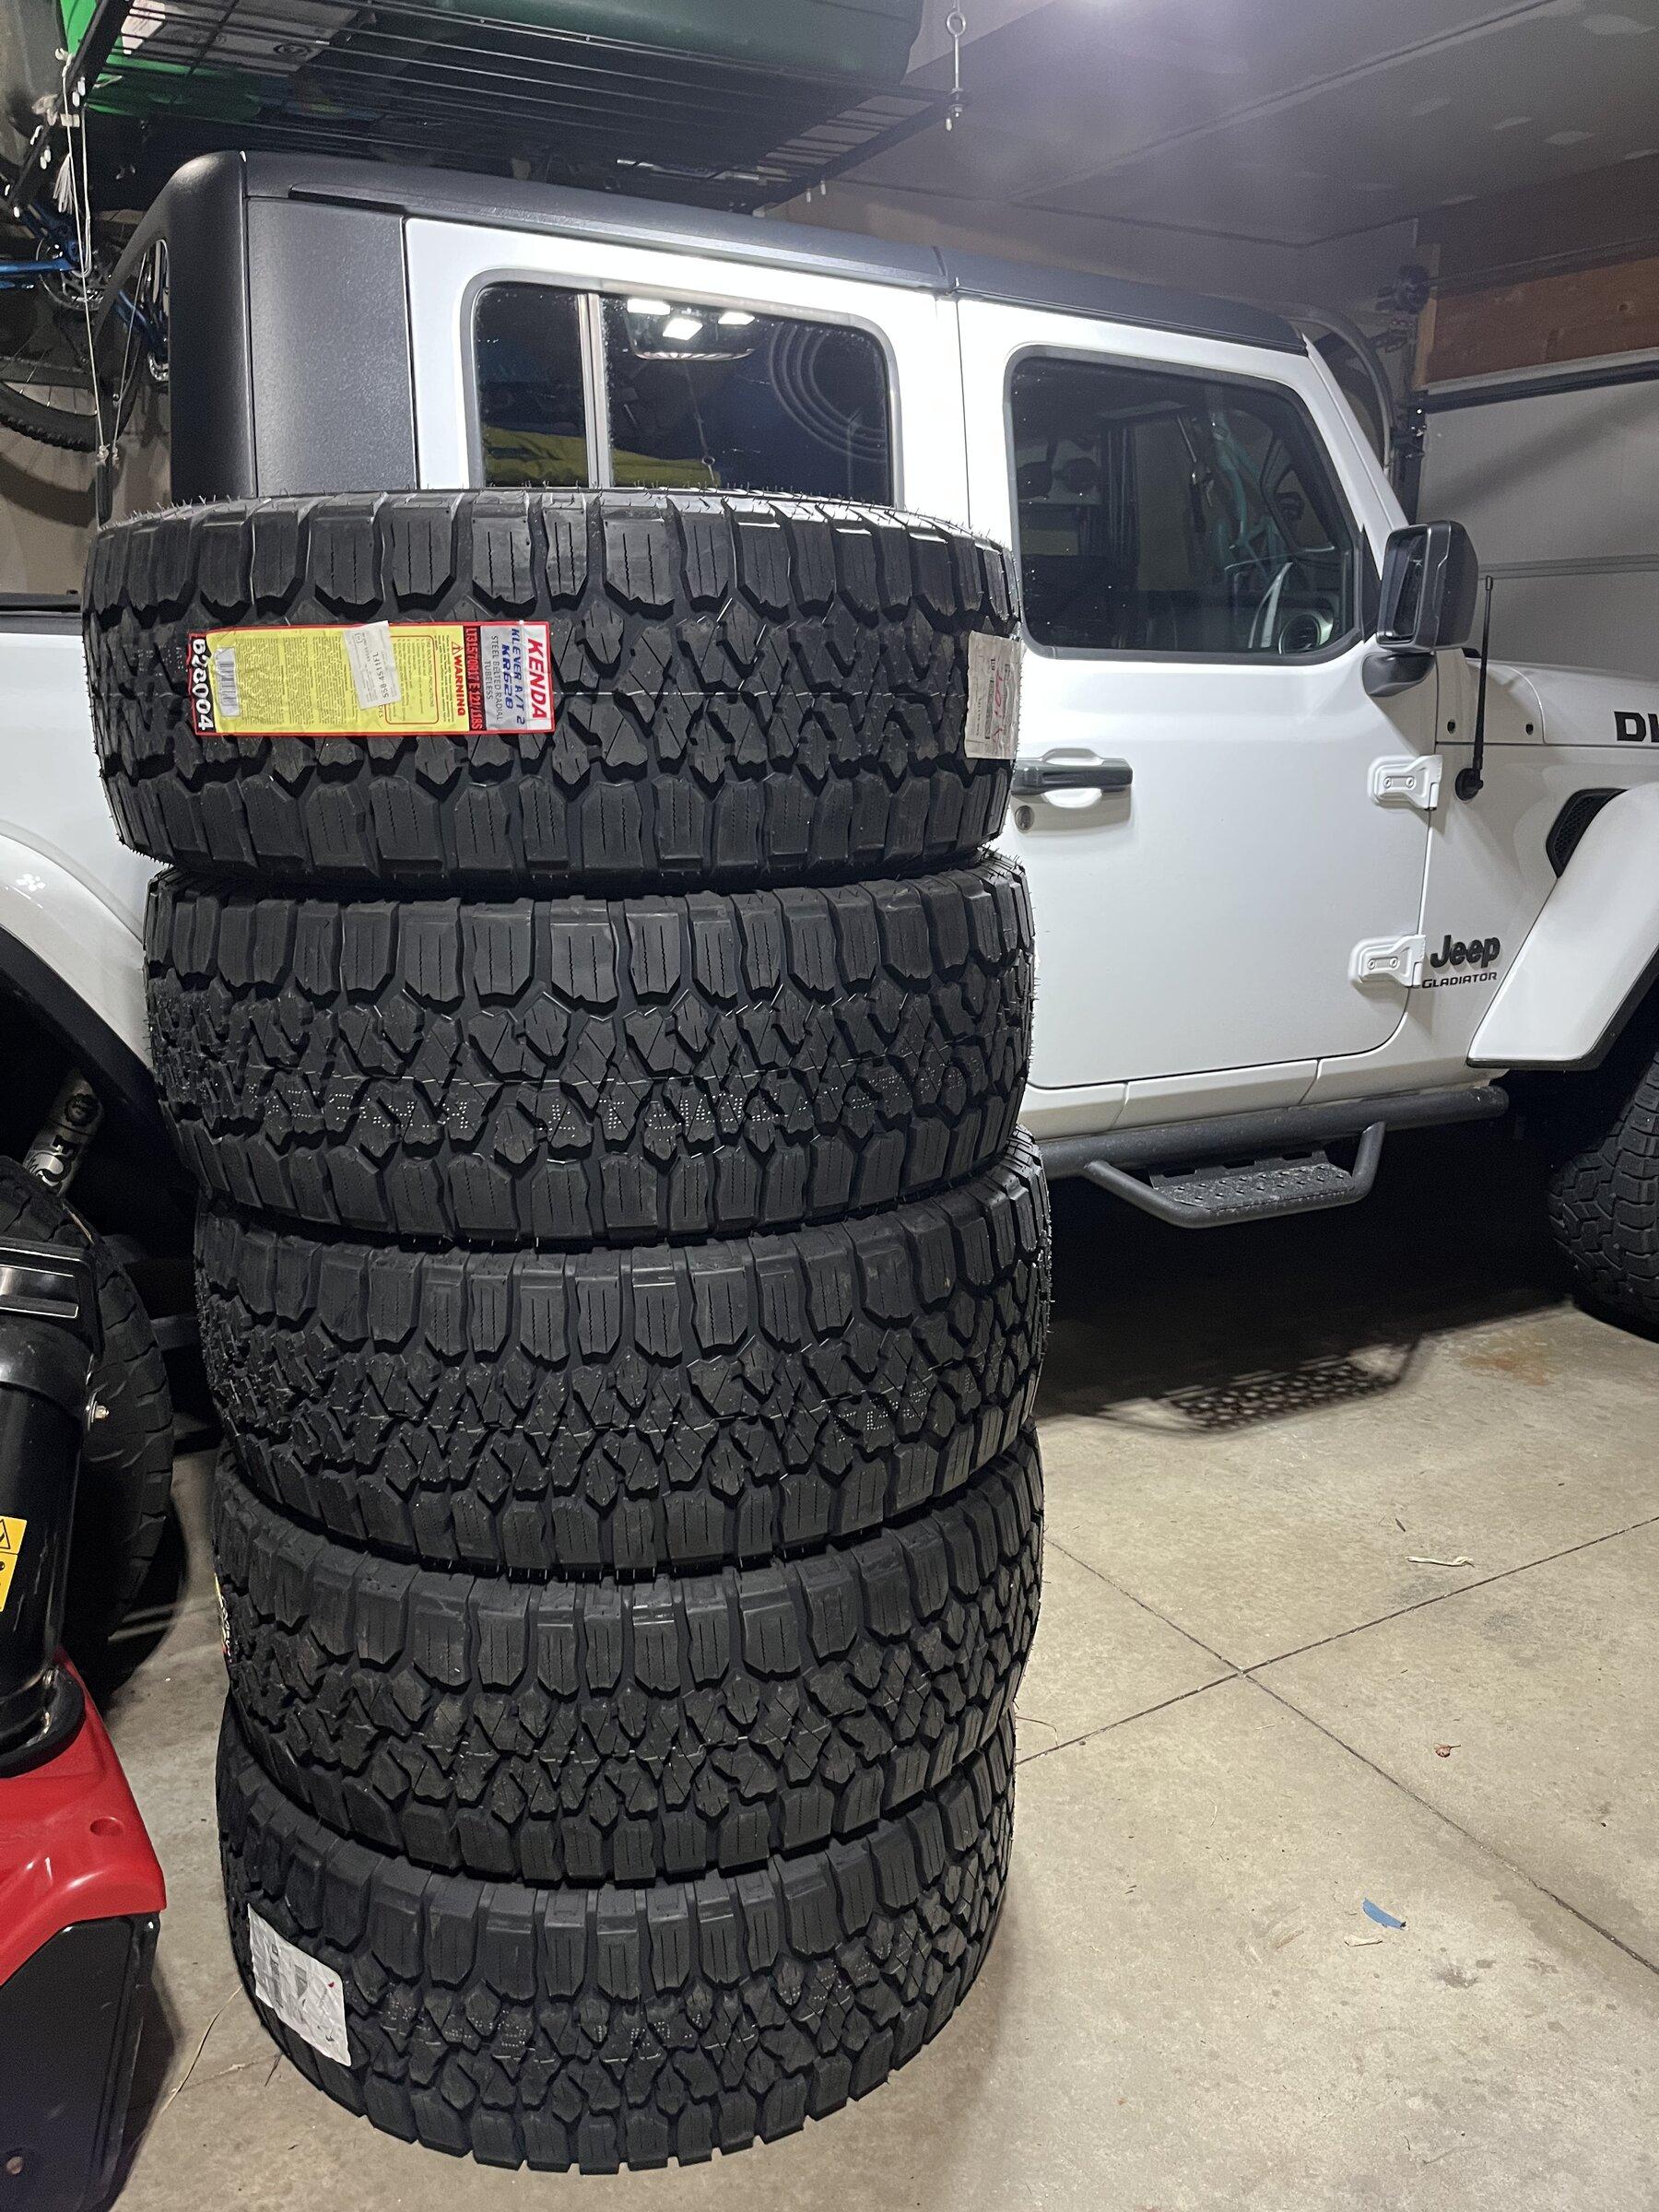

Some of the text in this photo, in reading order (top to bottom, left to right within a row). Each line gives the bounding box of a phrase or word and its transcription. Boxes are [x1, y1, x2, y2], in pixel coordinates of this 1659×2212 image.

[454, 654, 465, 716] WARNING
[484, 661, 493, 700] TUBELESS
[492, 661, 501, 690] BELTED
[501, 643, 514, 710] KR628
[512, 628, 525, 725] KLEVER A/T 2
[527, 638, 547, 718] KENDA
[495, 693, 503, 721] RADIAL
[1430, 935, 1501, 969] Jeep
[1421, 971, 1498, 989] GLADIATOR
